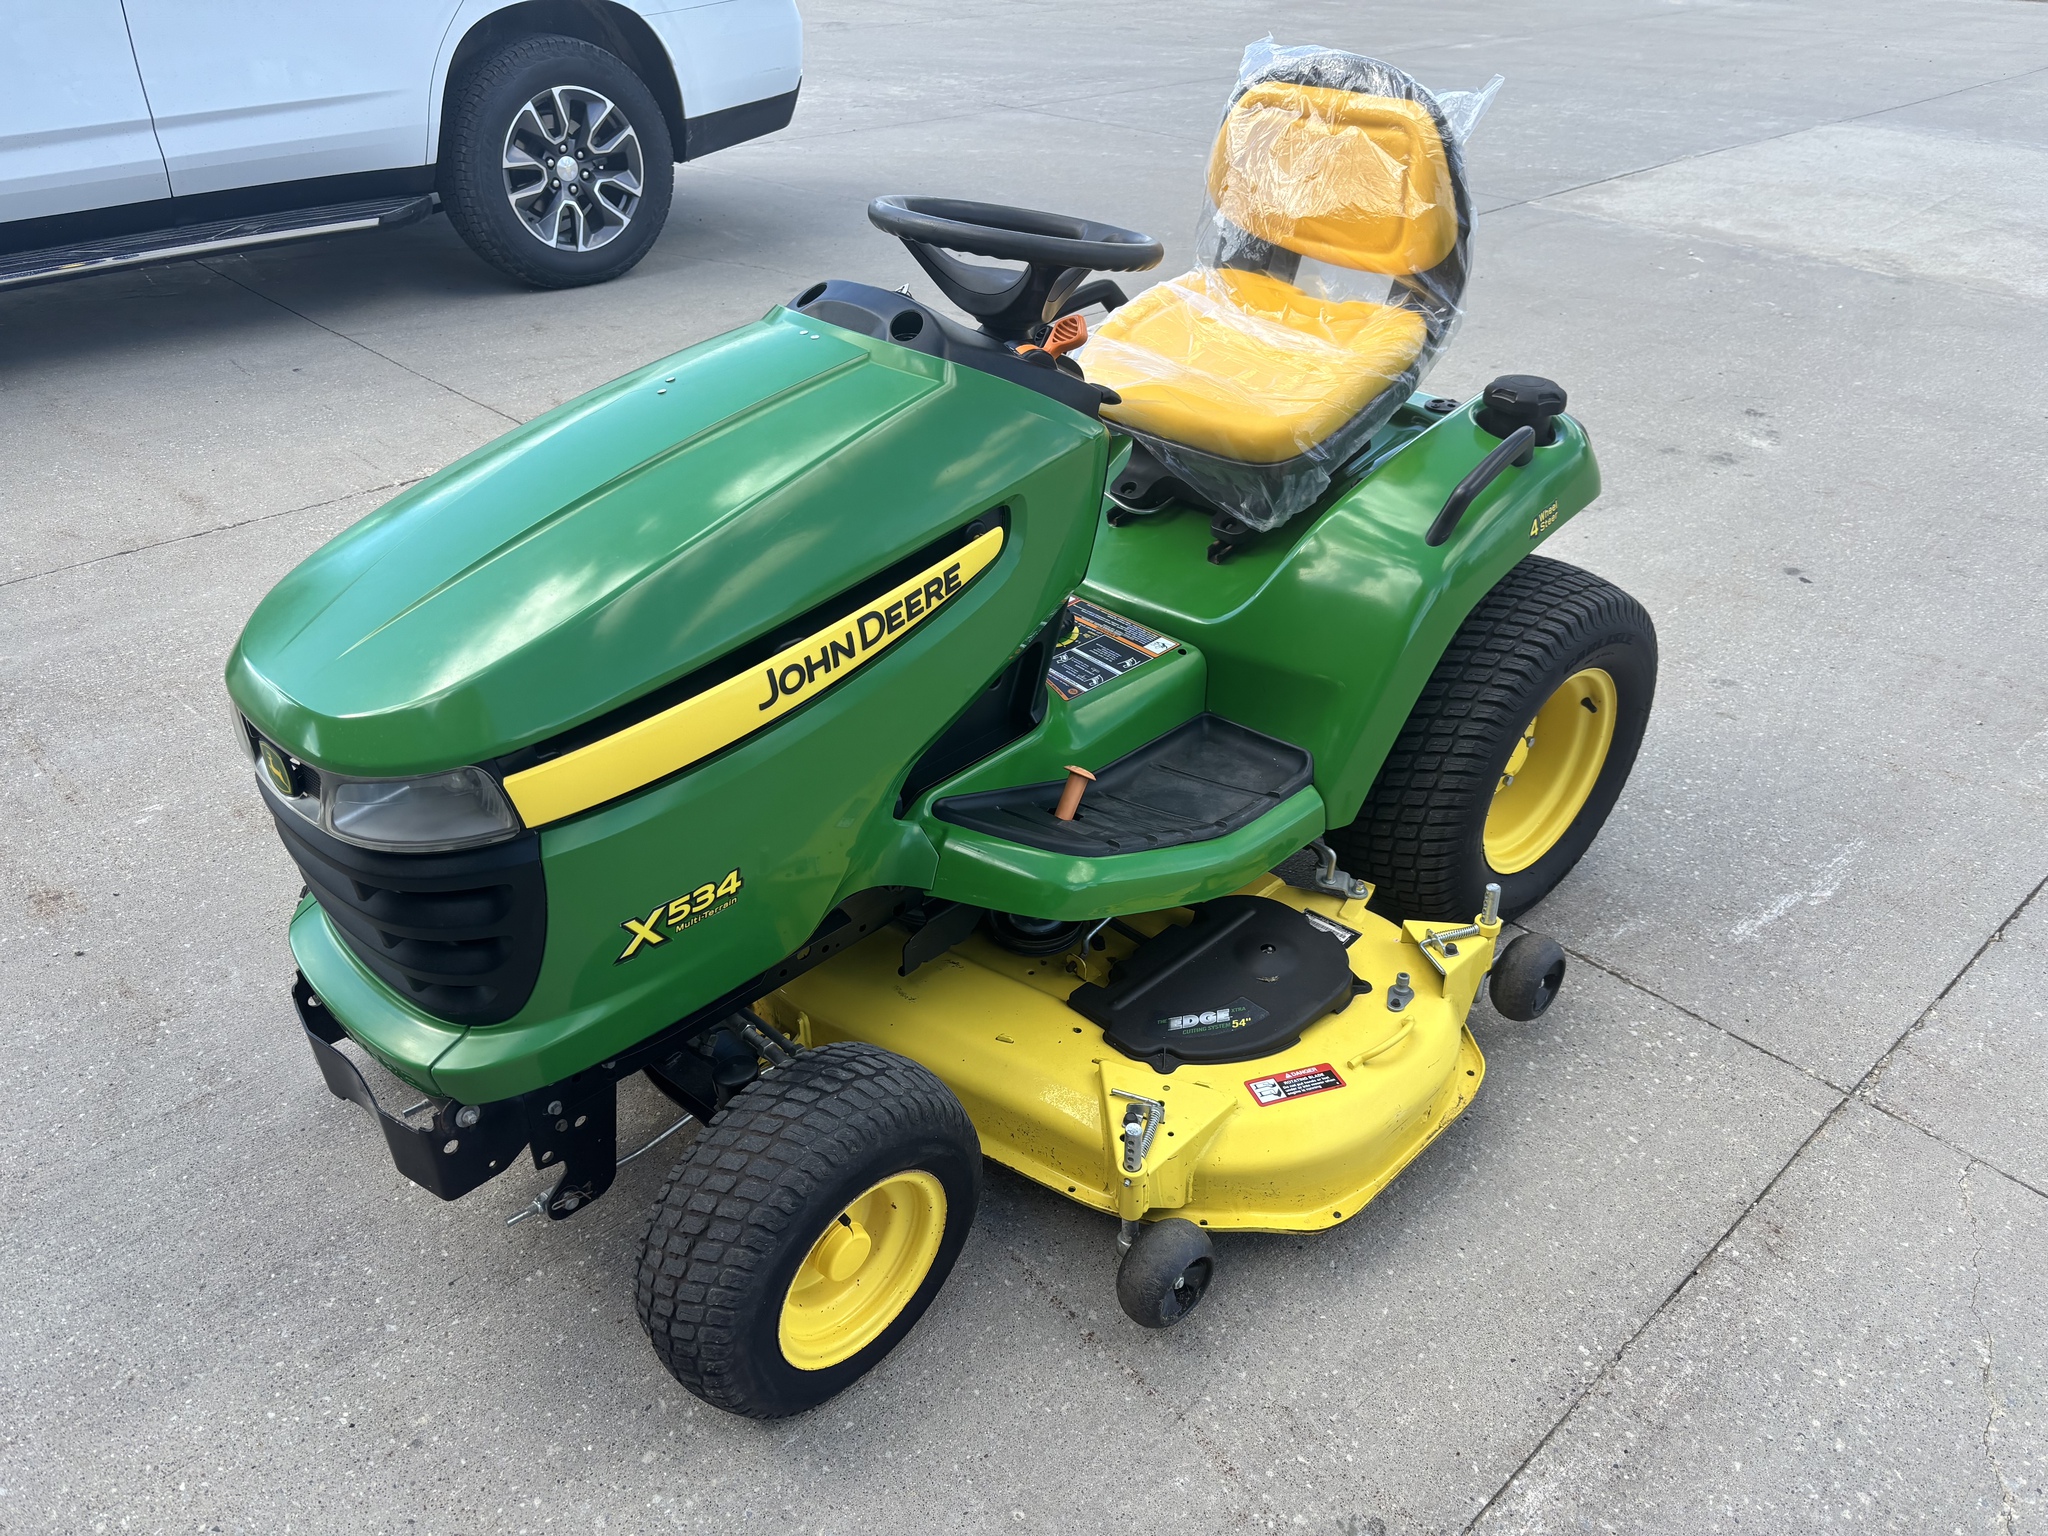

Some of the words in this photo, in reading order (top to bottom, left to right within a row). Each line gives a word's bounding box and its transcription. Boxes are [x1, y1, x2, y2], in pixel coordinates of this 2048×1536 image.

[1529, 518, 1539, 538] 4
[1538, 500, 1558, 522] Wheel
[1540, 512, 1558, 532] Steer
[759, 630, 856, 711] JOHN
[856, 562, 962, 651] DEERE
[616, 868, 743, 962] X534
[674, 896, 738, 933] Multi-Terrain
[1168, 1008, 1231, 1031] EDGE
[1182, 1025, 1207, 1035] CUTTING
[1207, 1022, 1231, 1031] SYSTEM
[1231, 1017, 1252, 1029] 54"
[1283, 1076, 1309, 1085] ROTATING
[1290, 1066, 1318, 1077] DANGER
